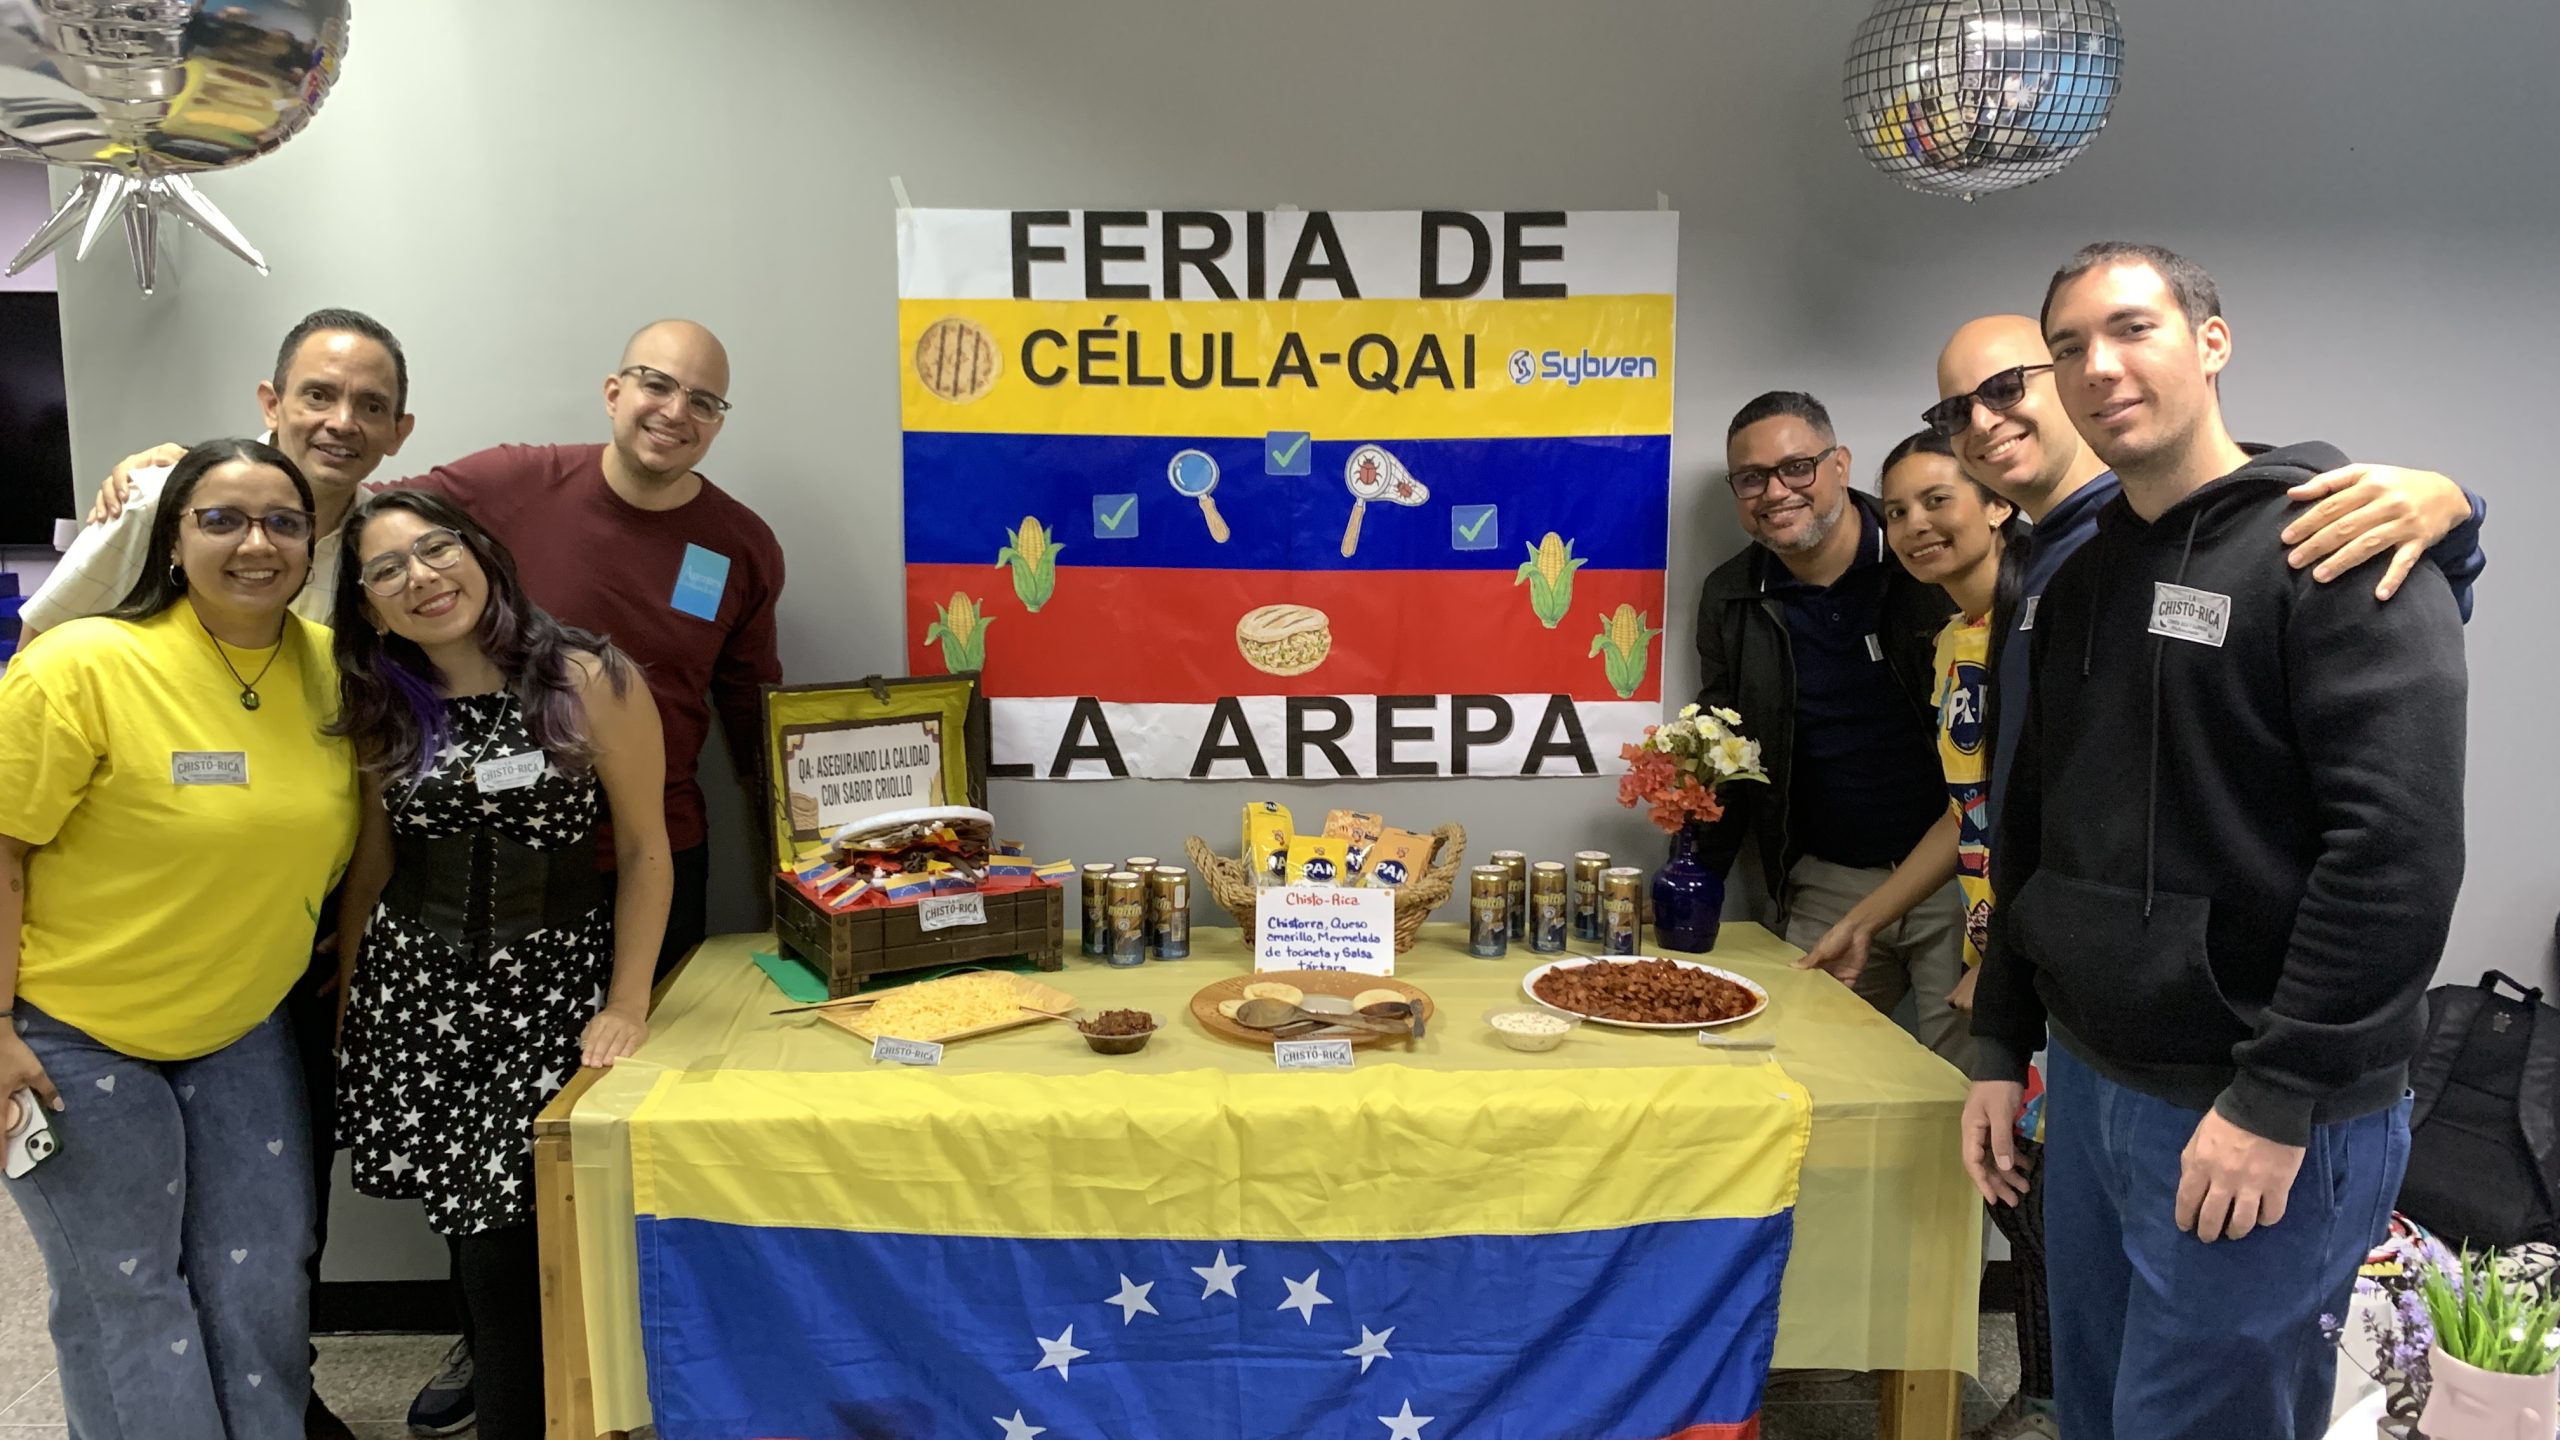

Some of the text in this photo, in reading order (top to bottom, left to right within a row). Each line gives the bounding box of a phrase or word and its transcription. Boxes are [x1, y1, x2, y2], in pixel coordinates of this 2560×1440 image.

[1010, 210, 1568, 301] FERIA DE
[1021, 313, 1477, 392] CÉLULA-QAI
[1541, 349, 1657, 386] Sybven
[2158, 600, 2220, 630] CHISTO-RICA
[1189, 694, 1599, 778] AREPA
[177, 760, 240, 774] CHISTO-RICA
[481, 763, 540, 784] CHISTO-RICA
[799, 744, 931, 784] QA: ASEGURANDO LA CALIDAD
[821, 775, 912, 806] CON SABOR CRIOLLO
[1303, 863, 1336, 877] PAN
[1375, 862, 1408, 883] PAN
[1286, 892, 1360, 907] Chisto-Rica
[925, 903, 979, 921] CHISTO-RICA
[1331, 917, 1368, 930] Queso
[1265, 945, 1281, 957] de
[1286, 946, 1331, 958] tocineta
[1333, 950, 1340, 962] y
[879, 1047, 934, 1061] CHISTO-RICA
[1283, 1050, 1346, 1063] CHISTO-RICA
